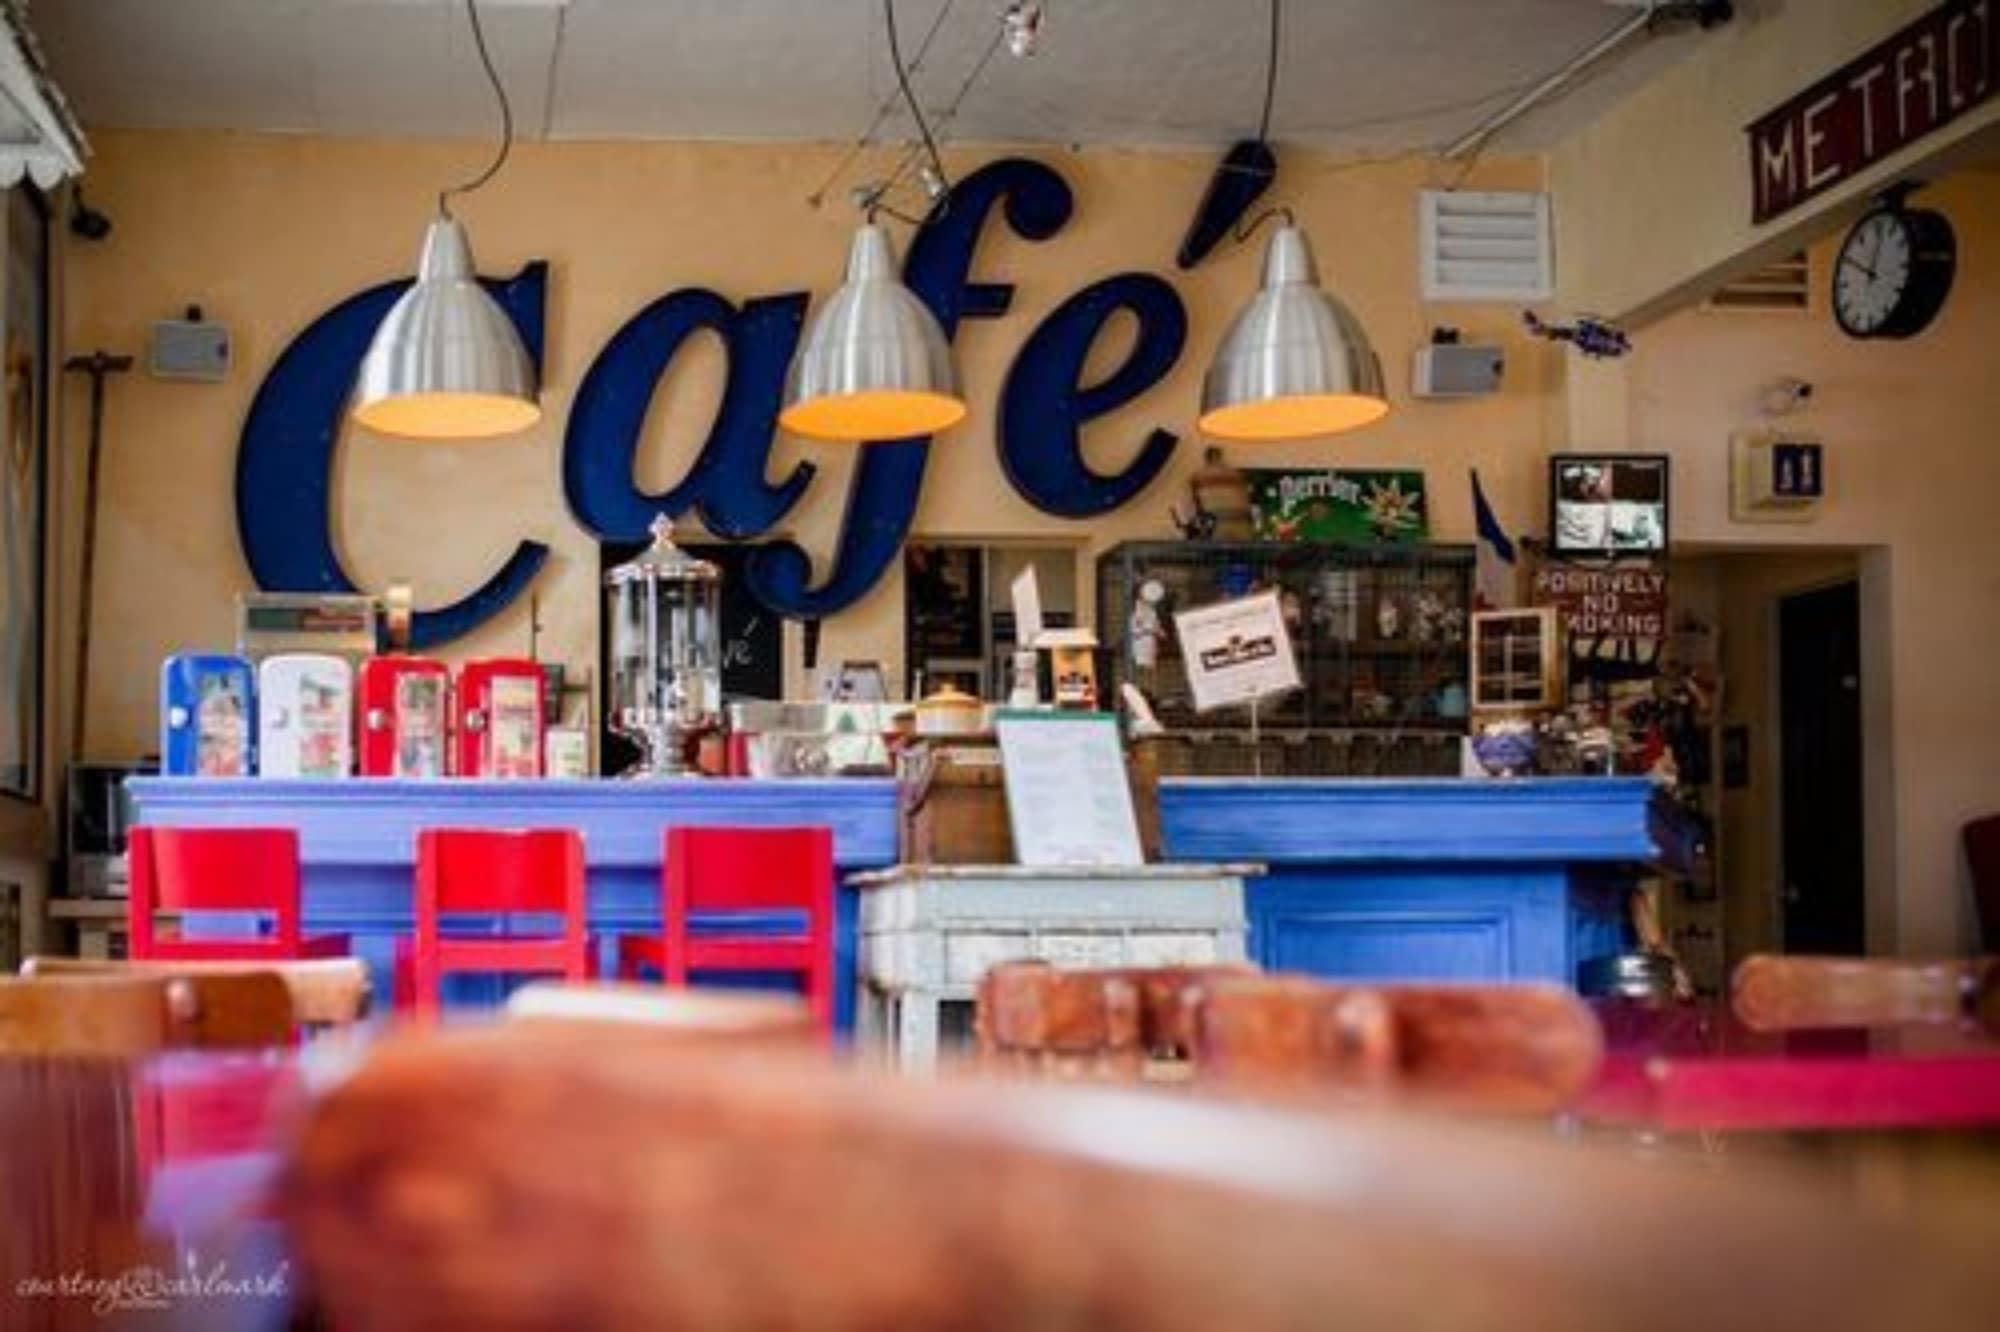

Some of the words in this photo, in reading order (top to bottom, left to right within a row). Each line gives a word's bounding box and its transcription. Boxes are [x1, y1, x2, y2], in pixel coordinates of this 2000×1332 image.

[1760, 0, 1990, 213] METRO
[236, 141, 1275, 651] Café
[1536, 571, 1664, 593] POSITIVELY
[1584, 594, 1619, 613] NO
[1566, 614, 1661, 635] MOKING
